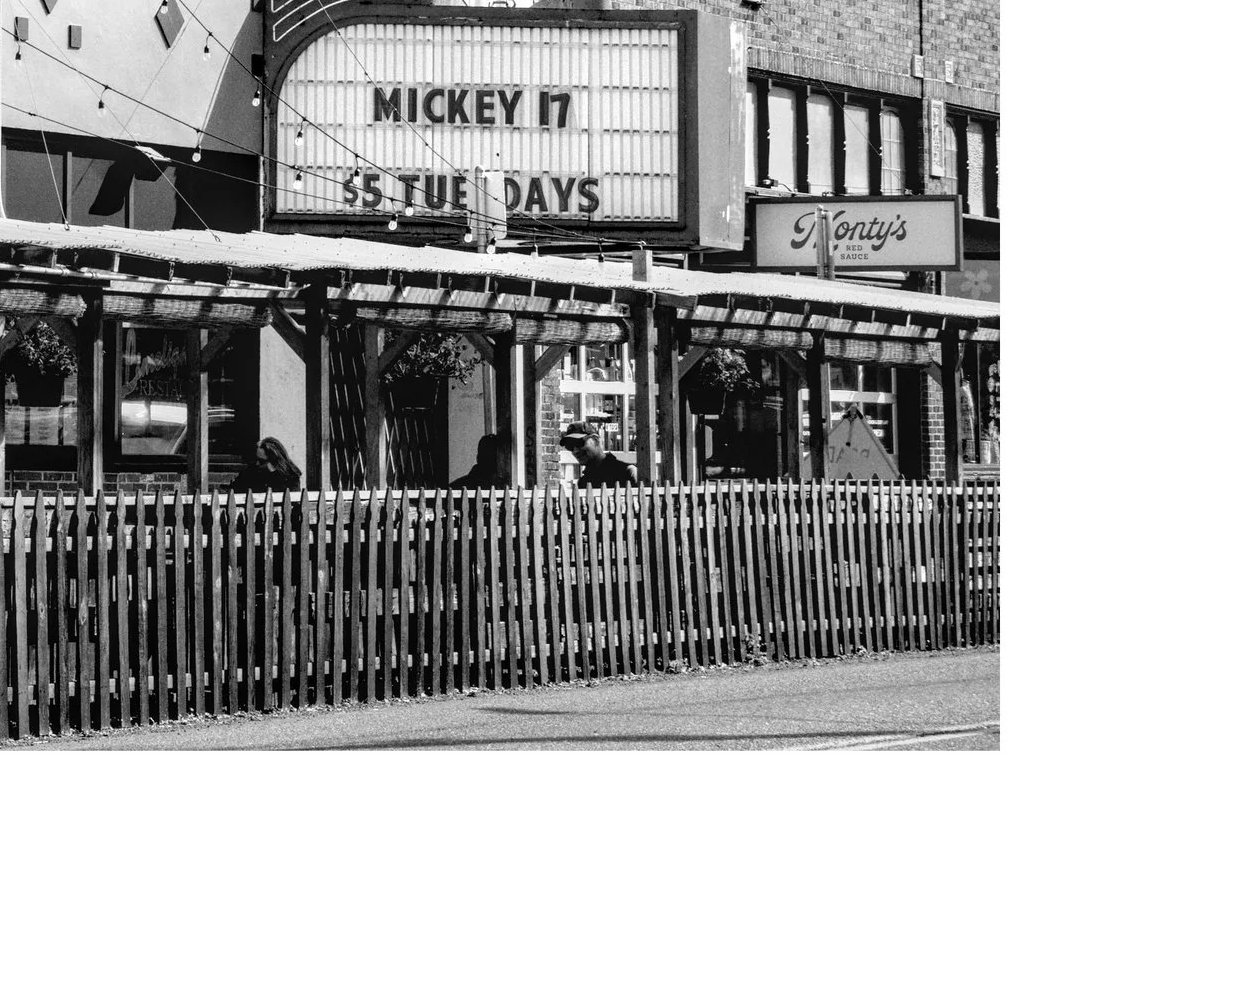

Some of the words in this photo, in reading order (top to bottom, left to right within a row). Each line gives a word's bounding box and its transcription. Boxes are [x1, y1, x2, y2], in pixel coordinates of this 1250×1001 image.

[373, 87, 523, 125] MICKEY
[539, 90, 572, 129] 17
[343, 173, 383, 208] $5
[398, 174, 600, 213] TUEDAYS
